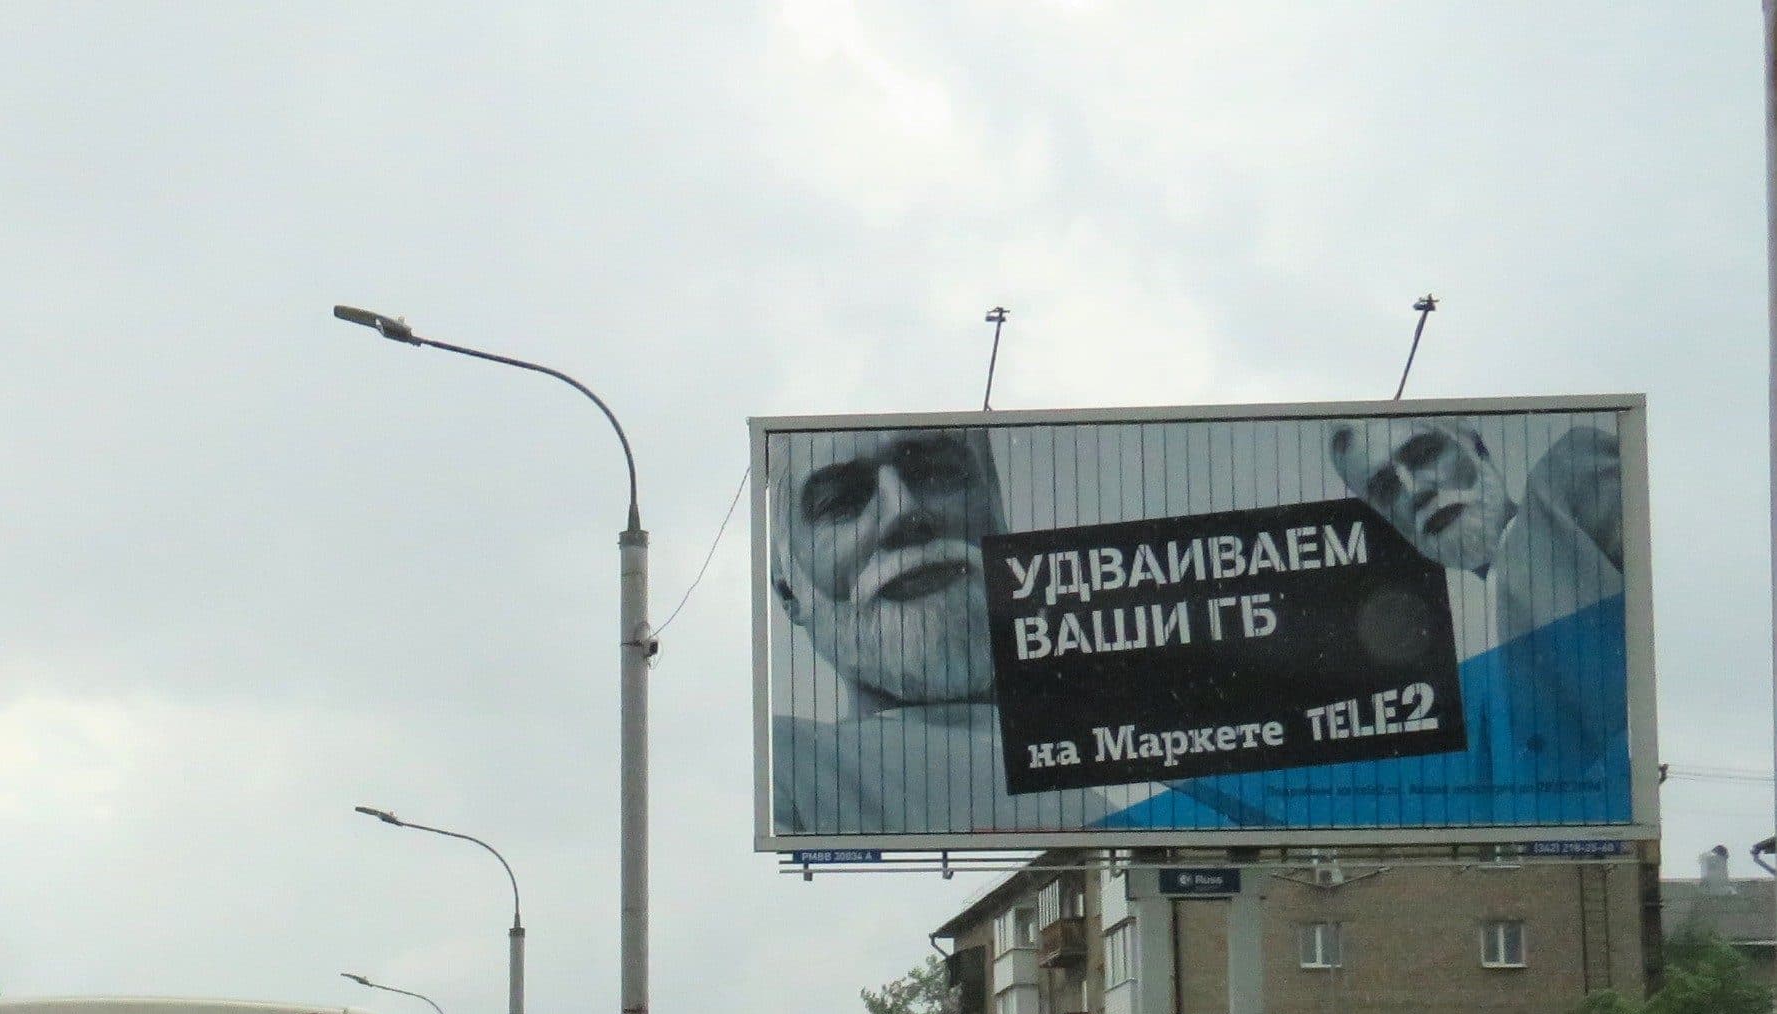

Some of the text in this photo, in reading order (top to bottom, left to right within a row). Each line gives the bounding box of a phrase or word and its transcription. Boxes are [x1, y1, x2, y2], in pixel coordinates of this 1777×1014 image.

[1006, 521, 1368, 605] УДВАИВАЕМ
[1014, 594, 1277, 660] ВАШИ ГБ
[1028, 682, 1439, 769] на Маркете TELE2
